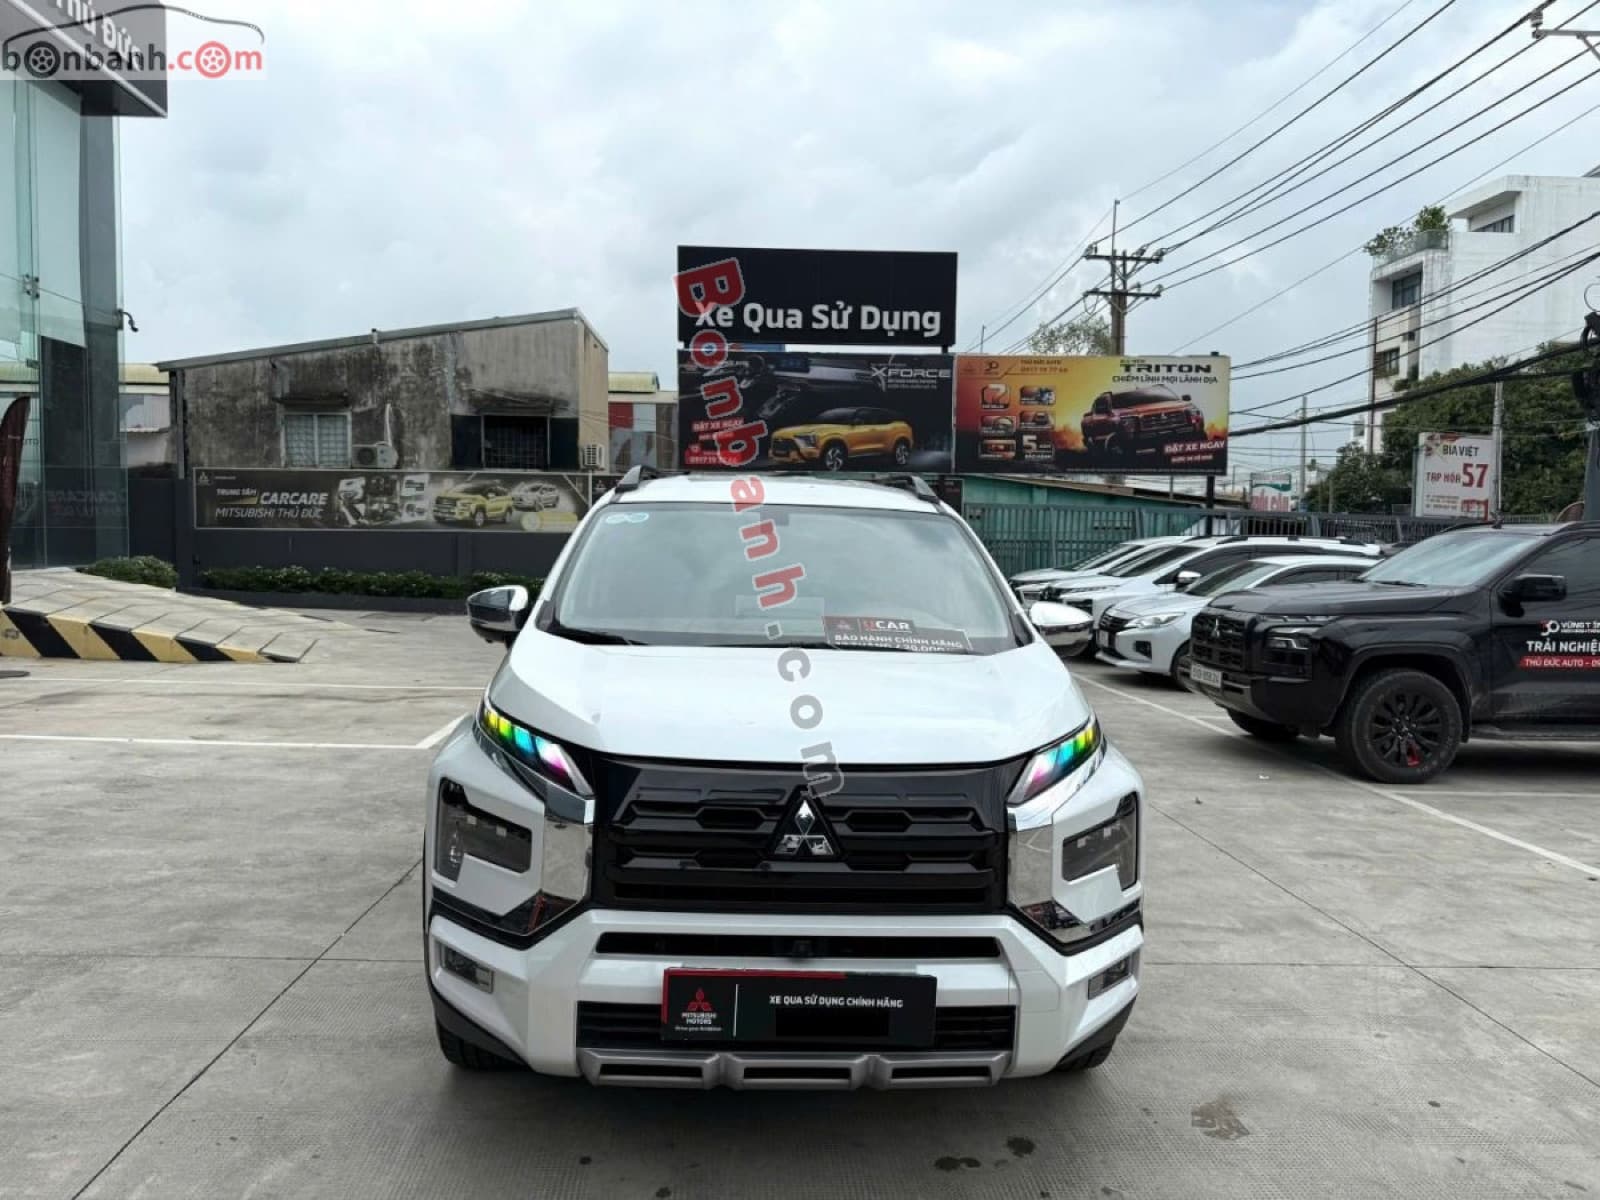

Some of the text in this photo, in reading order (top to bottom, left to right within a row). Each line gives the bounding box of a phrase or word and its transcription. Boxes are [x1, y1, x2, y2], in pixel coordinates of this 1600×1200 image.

[695, 301, 941, 337] Xe Qua Sử Dụng
[871, 367, 951, 379] XFORCE
[1120, 364, 1211, 373] TRITON
[1023, 435, 1037, 452] 5
[1442, 444, 1457, 456] BIA
[1462, 463, 1489, 488] 57
[260, 492, 329, 505] CARCARE
[215, 505, 324, 519] MITSUBISHI THỦ ĐỨC
[1526, 637, 1600, 655] TRẢI NGHIỆ
[1526, 656, 1542, 666] THỦ
[1543, 656, 1561, 666] ĐỨC
[1562, 658, 1584, 667] AUTO
[769, 995, 780, 1004] XE
[783, 996, 803, 1005] QUA
[804, 994, 818, 1005] SỬ
[819, 996, 844, 1007] DỤNG
[846, 996, 875, 1006] CHÍNH
